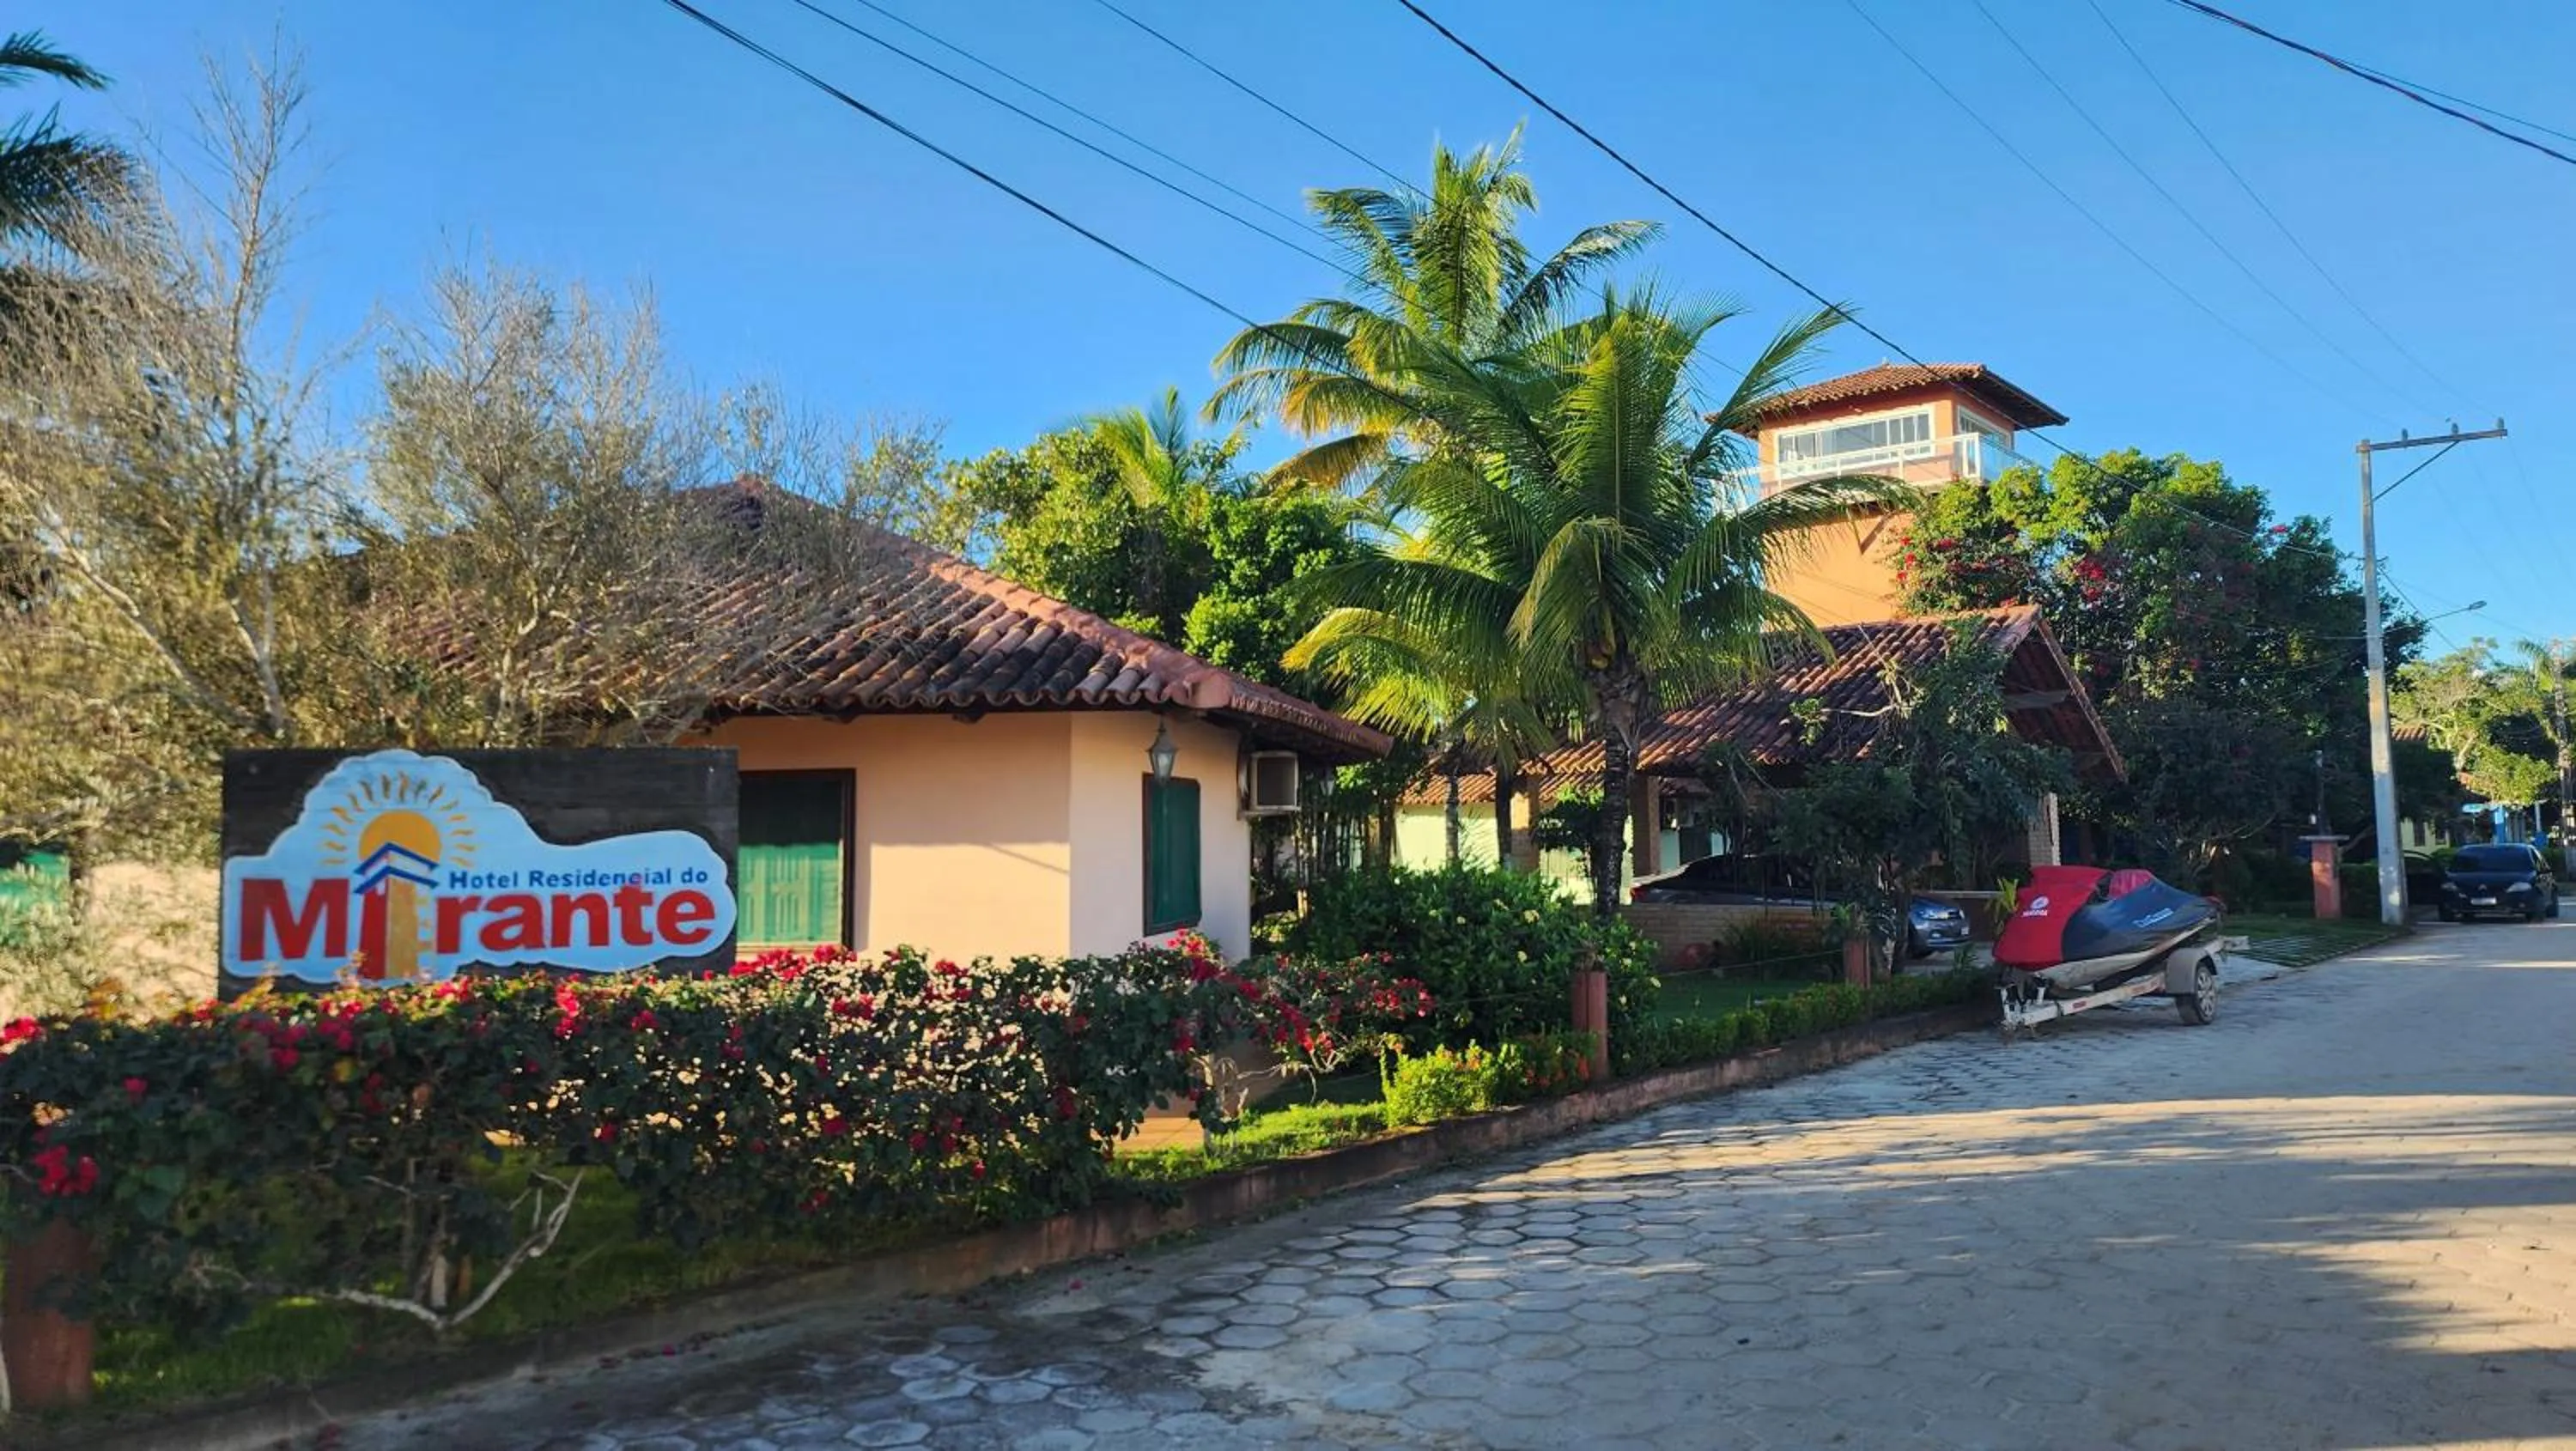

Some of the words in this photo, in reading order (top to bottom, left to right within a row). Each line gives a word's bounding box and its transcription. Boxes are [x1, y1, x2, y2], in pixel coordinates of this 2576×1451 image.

[449, 871, 519, 889] Hotel
[529, 868, 671, 888] Residencial
[681, 867, 708, 884] do
[240, 876, 716, 980] Mirante
